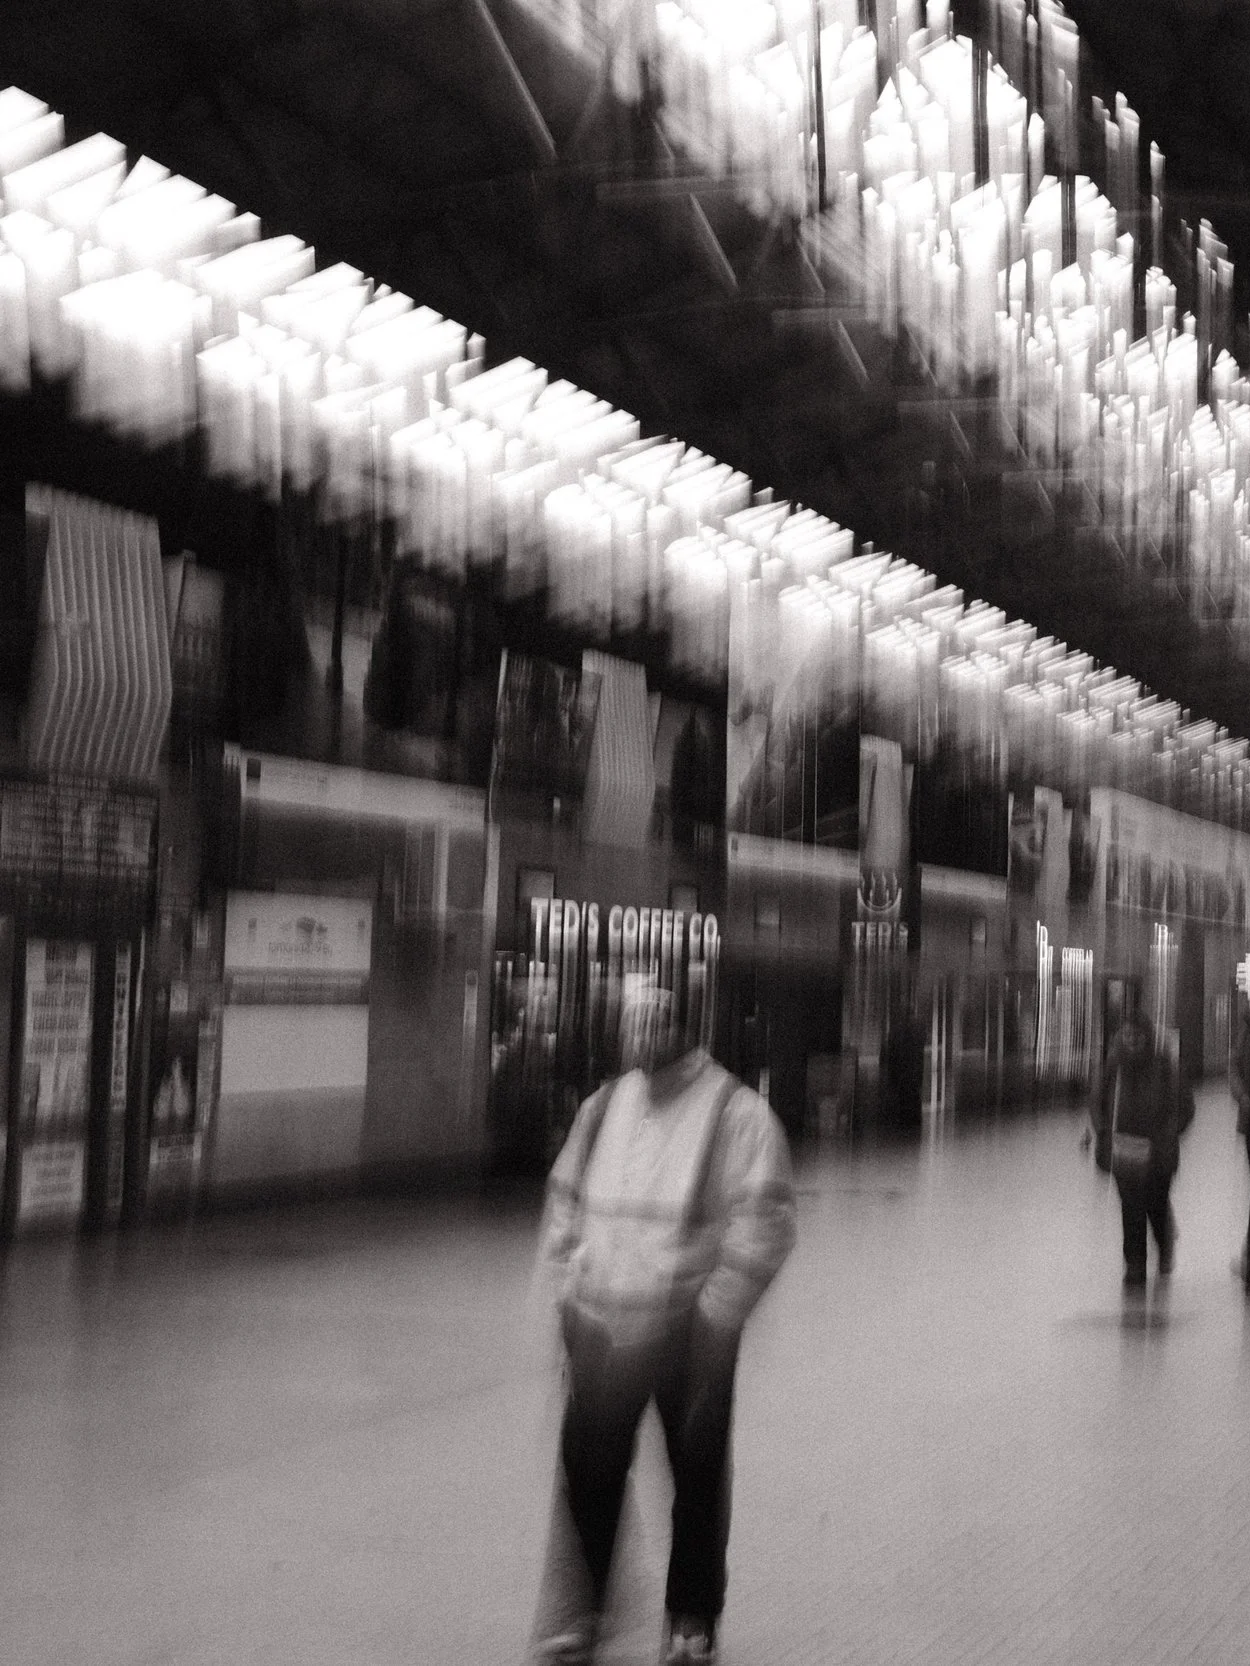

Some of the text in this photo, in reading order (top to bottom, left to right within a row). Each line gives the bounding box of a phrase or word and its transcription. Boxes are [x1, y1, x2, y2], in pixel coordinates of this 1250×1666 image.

[531, 897, 599, 940] TED'S
[608, 904, 684, 944] COFFEE
[851, 921, 908, 940] TED'S
